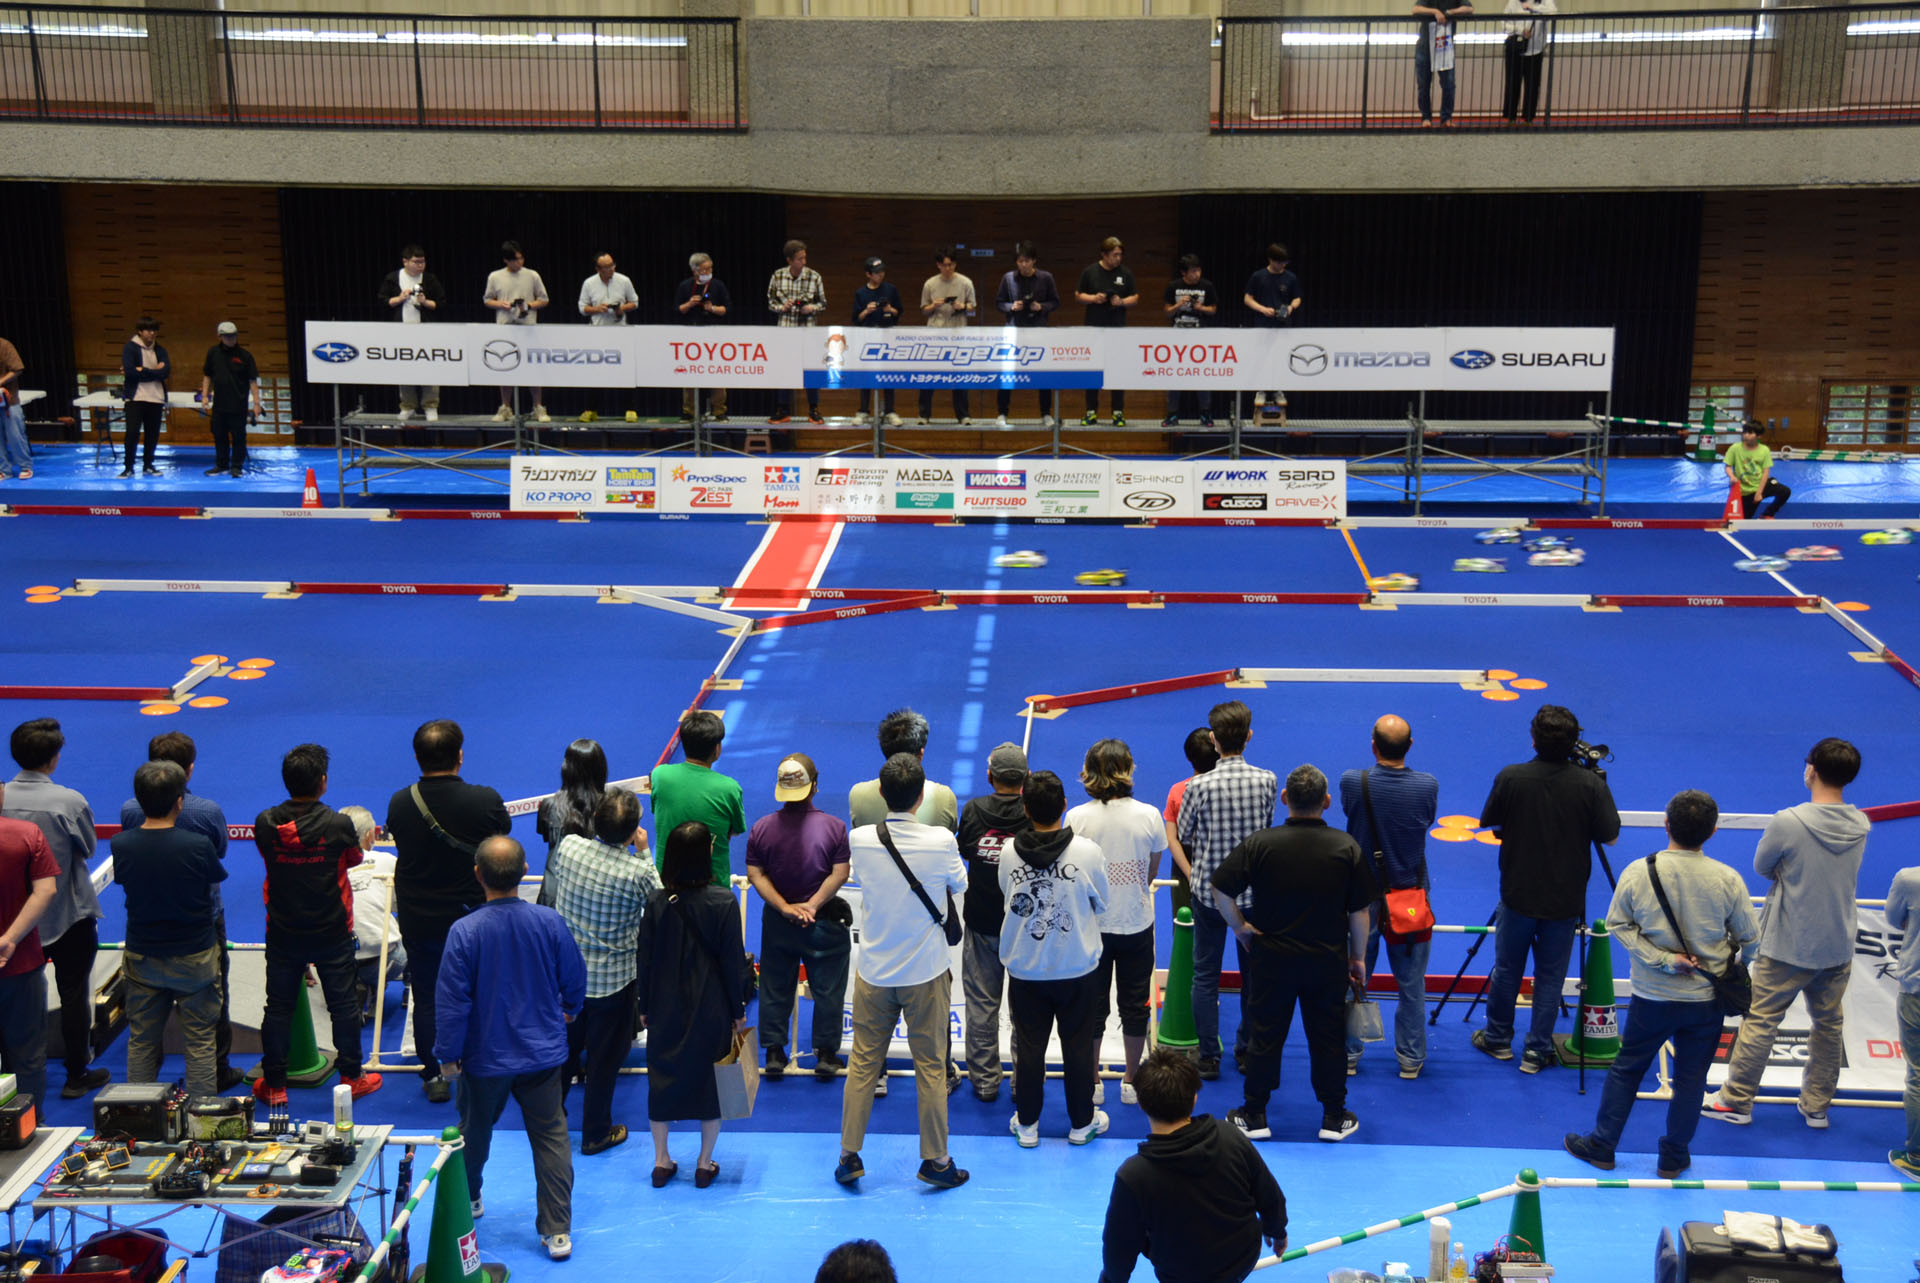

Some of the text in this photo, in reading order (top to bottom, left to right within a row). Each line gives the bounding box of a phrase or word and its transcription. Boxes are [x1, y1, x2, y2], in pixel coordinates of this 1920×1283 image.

[366, 347, 463, 362] SUBARU
[669, 342, 768, 361] TOYOTA
[1051, 346, 1092, 355] TOYOTA
[1139, 344, 1238, 363] TOYOTA
[527, 348, 622, 365] mazda
[1333, 351, 1431, 367] mazda
[1501, 353, 1606, 367] SUBARU
[689, 365, 765, 375] RC CAR CLUB
[1157, 367, 1234, 377] RC CAR CLUB
[909, 374, 998, 384] トヨタチャレンジカップ
[521, 466, 597, 481] ラジコンマガジン
[608, 469, 653, 480] TamTam
[896, 469, 954, 481] MAEDA
[1226, 470, 1268, 480] WORK
[815, 474, 847, 485] GR
[1133, 474, 1184, 484] SHINKO
[304, 487, 317, 500] 10
[526, 491, 592, 501] KO PROPO
[963, 497, 1027, 506] FUJITSUBO
[1730, 499, 1739, 513] 1
[89, 507, 122, 515] TOYOTA
[1041, 505, 1089, 514] 三和工業
[471, 511, 502, 519] TOYOTA
[1417, 519, 1448, 527] TOYOTA
[1611, 521, 1644, 529] TOYOTA
[1811, 521, 1844, 529] TOYOTA
[381, 585, 417, 594] TOYOTA
[810, 590, 845, 598] TOYOTA
[1033, 595, 1069, 603] TOYOTA
[1242, 594, 1278, 603] TOYOTA
[1463, 596, 1498, 604] TOYOTA
[1687, 598, 1724, 606] TOYOTA
[835, 607, 867, 619] TOYOTA
[507, 800, 541, 814] OYOT
